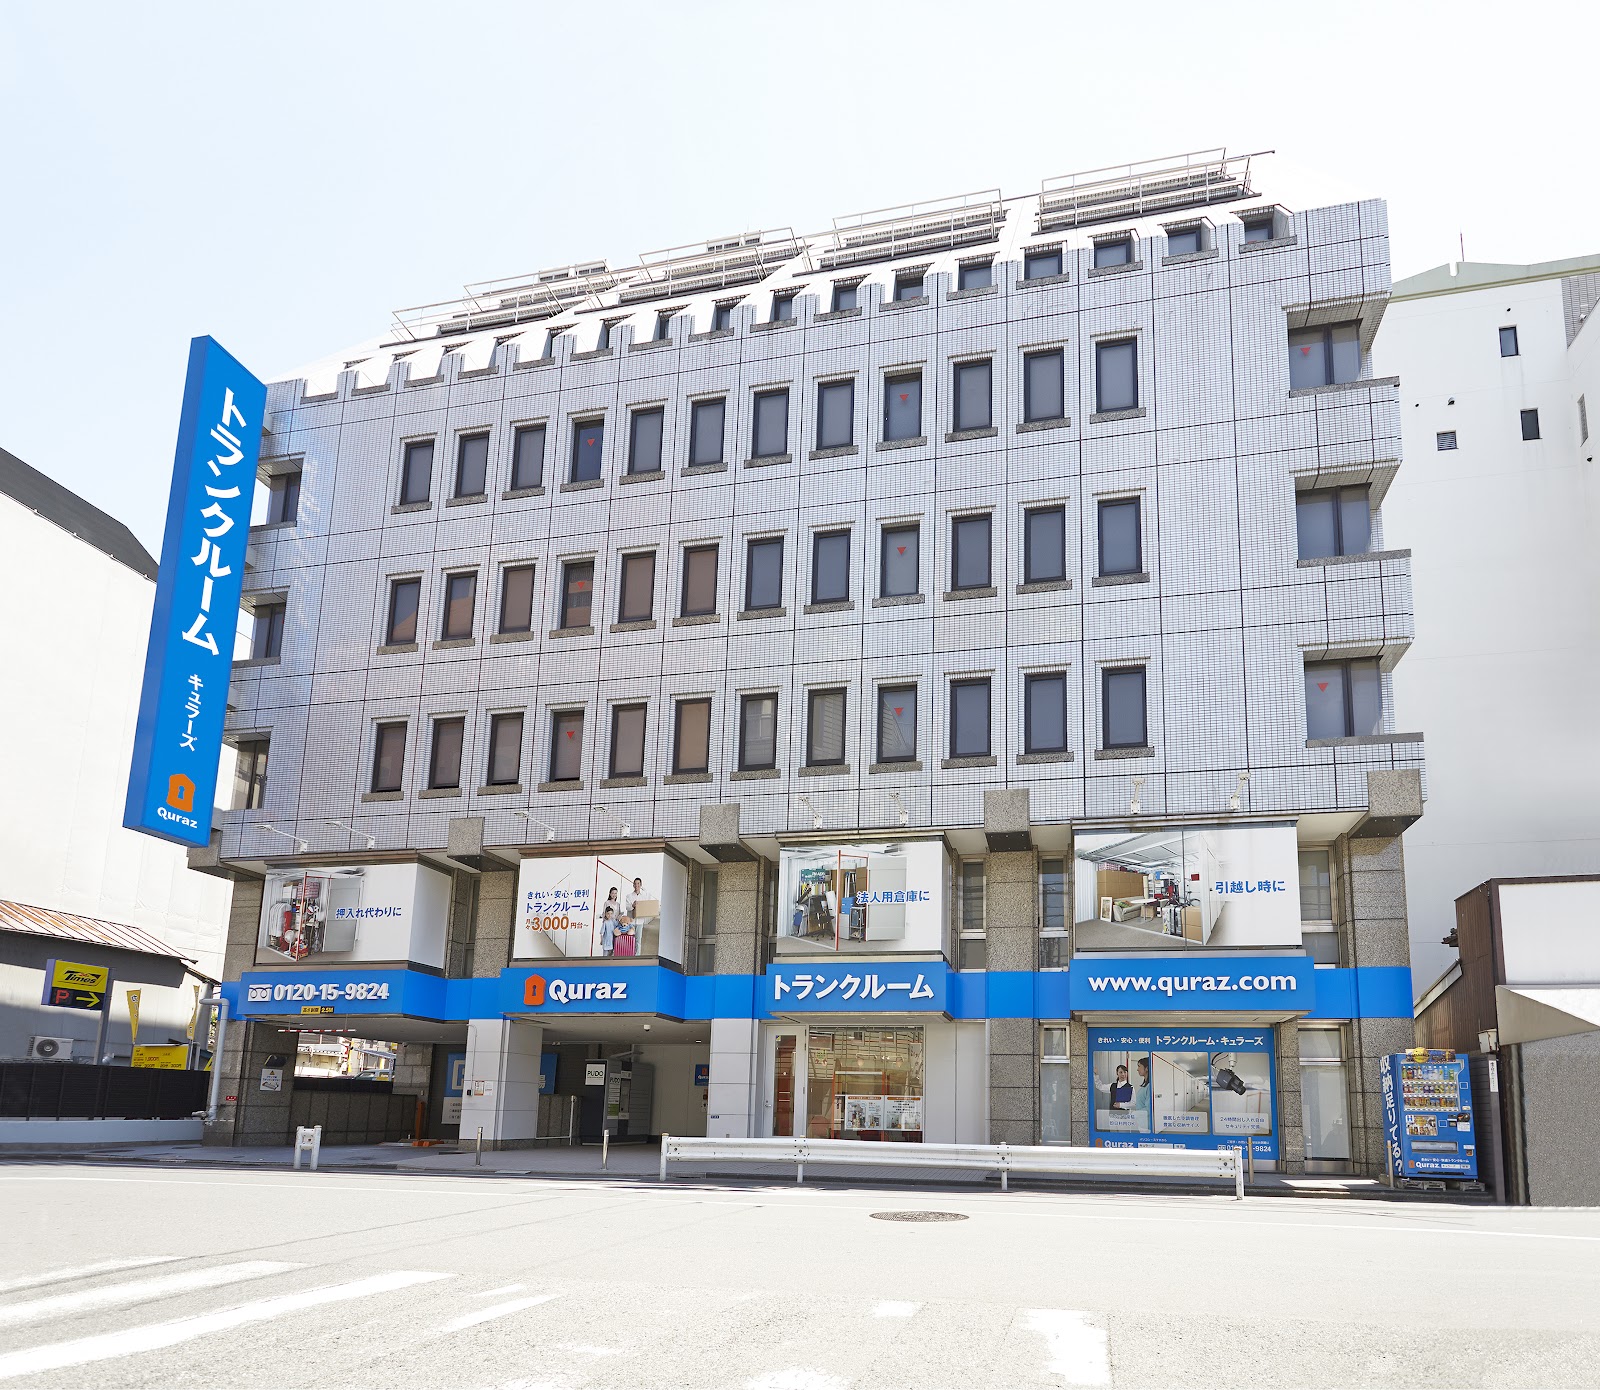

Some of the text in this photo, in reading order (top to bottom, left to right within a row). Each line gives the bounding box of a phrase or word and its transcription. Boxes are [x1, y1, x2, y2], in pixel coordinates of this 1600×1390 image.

[182, 387, 247, 655] トランクルーム
[179, 674, 203, 751] キュラーズ
[157, 806, 198, 829] Quraz
[1215, 880, 1286, 894] 引越し時に
[527, 889, 590, 900] きれい・安心・便利
[856, 890, 930, 903] 法人用倉庫に
[335, 906, 402, 919] 押入れ代わりに
[526, 901, 589, 914] トランクルーム
[64, 970, 102, 984] Times
[273, 982, 390, 1001] 0120-15-9824
[548, 979, 627, 1005] Quraz
[774, 973, 935, 1001] トランクルーム
[1087, 974, 1297, 998] www.quraz.com
[55, 989, 70, 1004] P
[1156, 1035, 1264, 1046] トランクルーム・キュラーズ
[1380, 1055, 1403, 1176] 収納足りてる？
[1104, 1140, 1134, 1149] Quraz
[1415, 1161, 1440, 1169] Quraz
